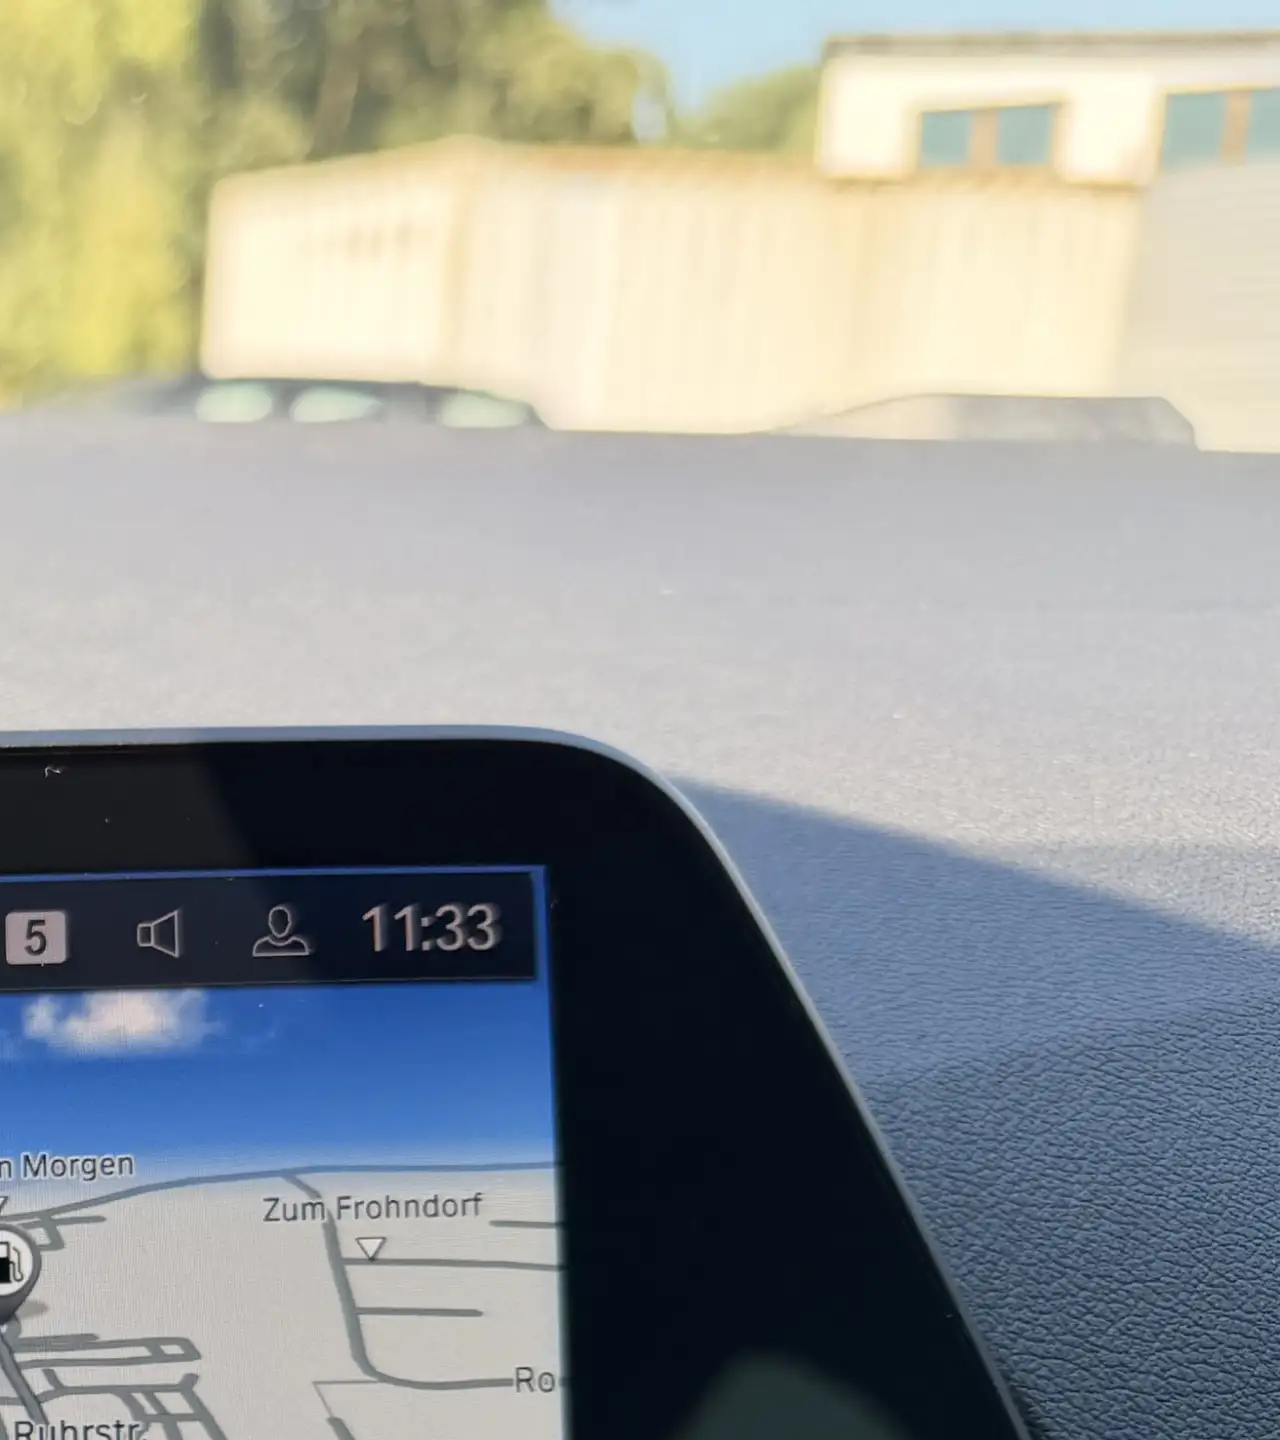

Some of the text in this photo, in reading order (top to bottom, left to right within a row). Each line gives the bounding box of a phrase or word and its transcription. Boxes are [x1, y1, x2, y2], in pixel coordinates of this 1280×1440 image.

[24, 919, 48, 956] 5
[362, 903, 499, 952] 11:33
[23, 1152, 134, 1183] Morgen
[263, 1192, 483, 1222] Zum Frohndorf
